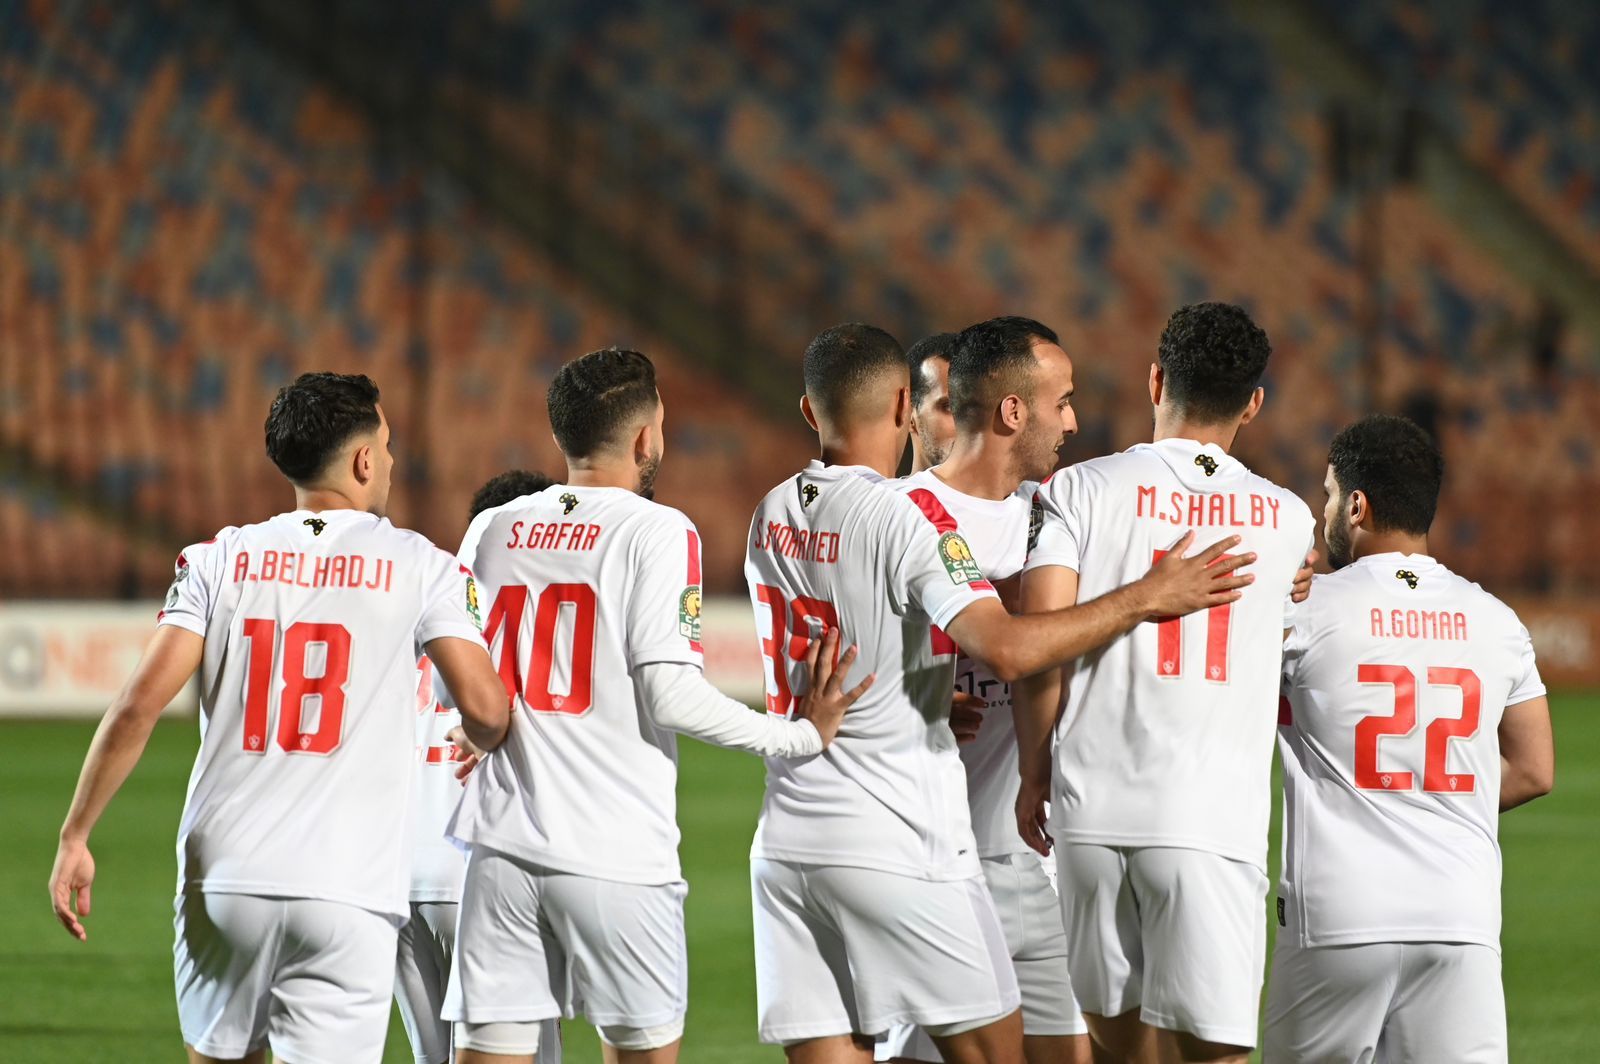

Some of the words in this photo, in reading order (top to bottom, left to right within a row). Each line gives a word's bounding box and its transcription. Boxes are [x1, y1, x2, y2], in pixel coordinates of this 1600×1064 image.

[1136, 485, 1280, 529] M.SHALBY
[507, 521, 600, 551] S.GAFAR
[755, 519, 840, 564] S.MOHAMED
[233, 550, 393, 593] A.BELHADJI
[1370, 607, 1468, 641] A.GOMAA
[482, 583, 599, 716] 10
[243, 618, 352, 756] 18
[1354, 663, 1482, 793] 22
